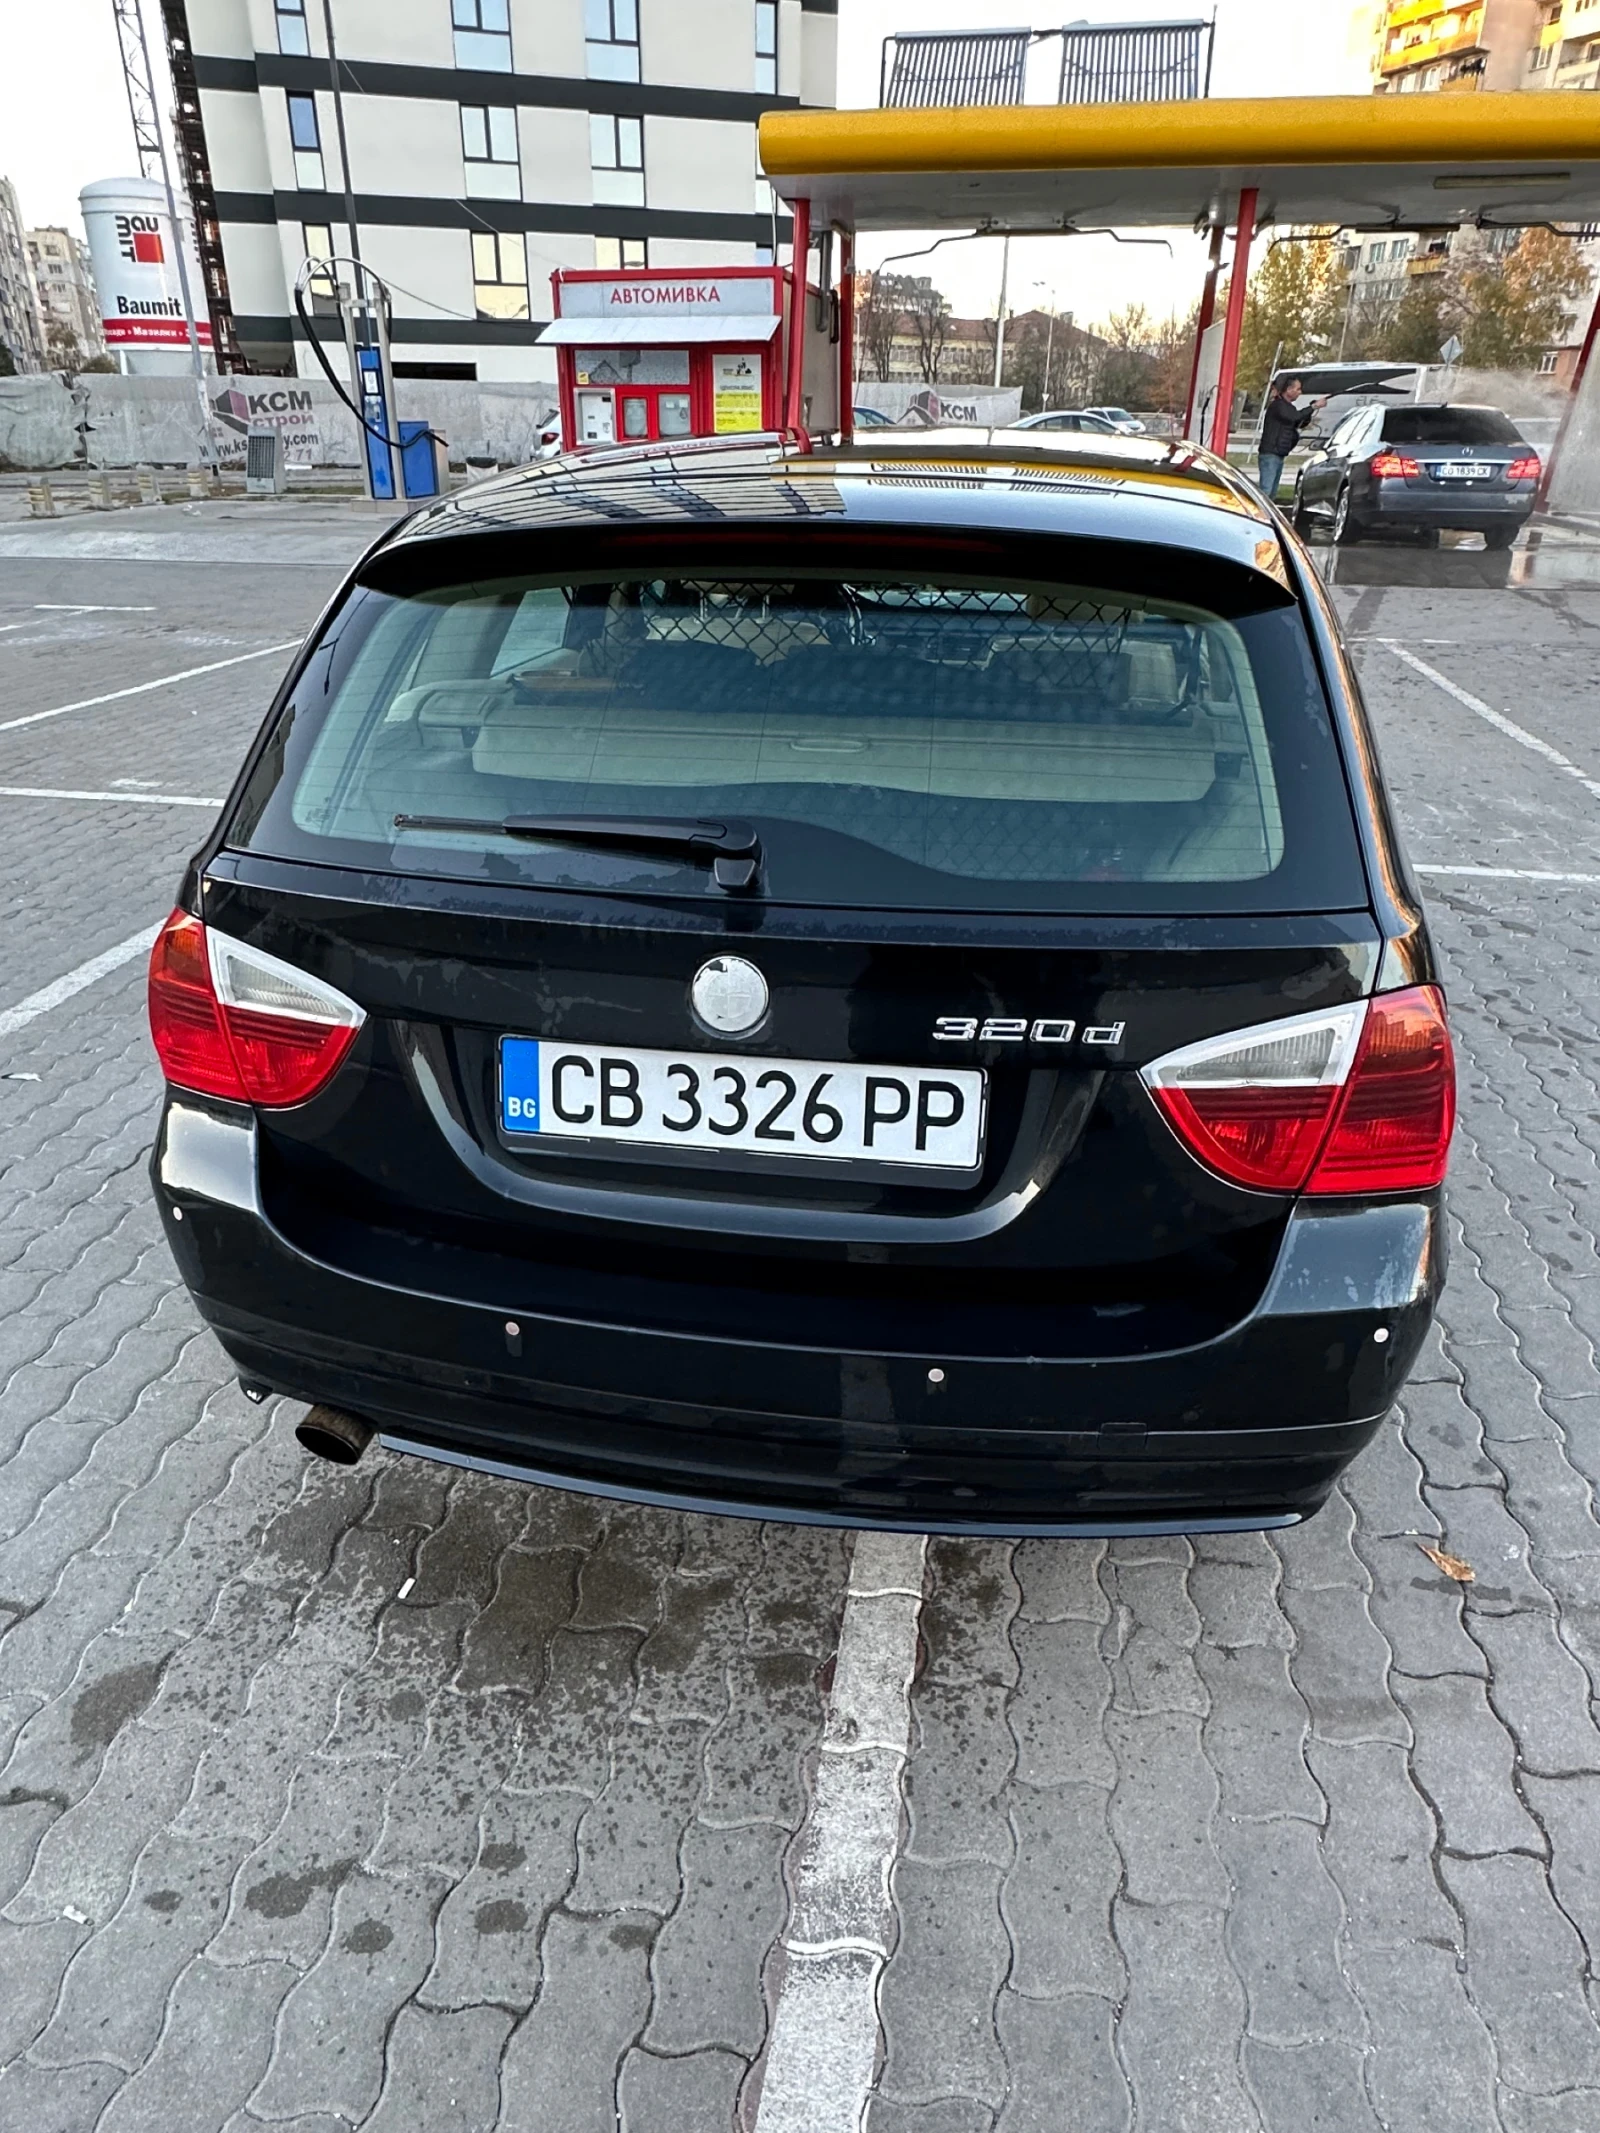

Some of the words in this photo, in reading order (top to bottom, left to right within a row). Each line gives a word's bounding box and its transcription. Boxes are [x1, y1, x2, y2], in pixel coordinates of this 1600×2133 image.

[116, 295, 183, 317] Baumit
[610, 285, 721, 305] АВТОМИВКА
[932, 1015, 1127, 1047] 320d
[507, 1096, 537, 1119] BG
[550, 1053, 644, 1128] CB
[661, 1062, 844, 1144] 3326
[863, 1075, 966, 1152] PP
